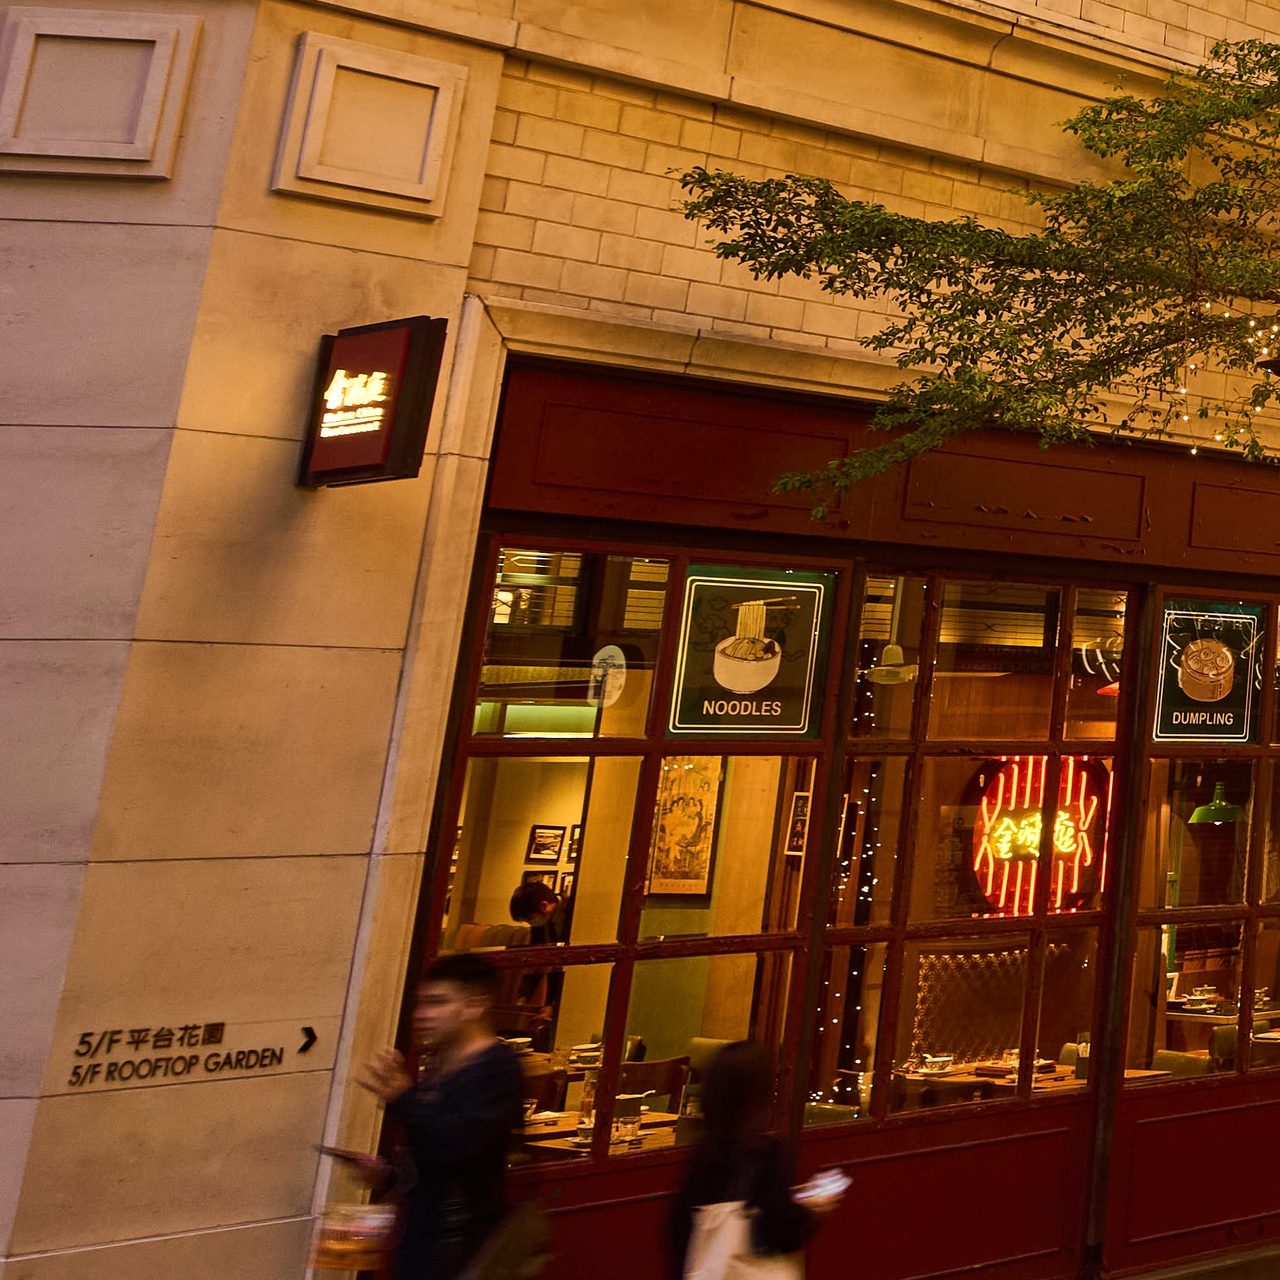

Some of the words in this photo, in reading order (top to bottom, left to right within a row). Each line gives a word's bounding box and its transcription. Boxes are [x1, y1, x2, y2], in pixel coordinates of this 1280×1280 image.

[703, 700, 782, 716] NOODLES
[1172, 712, 1234, 725] DUMPLING
[74, 1029, 123, 1058] 5/F
[126, 1022, 225, 1051] 平台花園
[68, 1063, 101, 1087] 5/F
[105, 1054, 201, 1082] ROOFTOP
[204, 1047, 284, 1073] GARDEN
